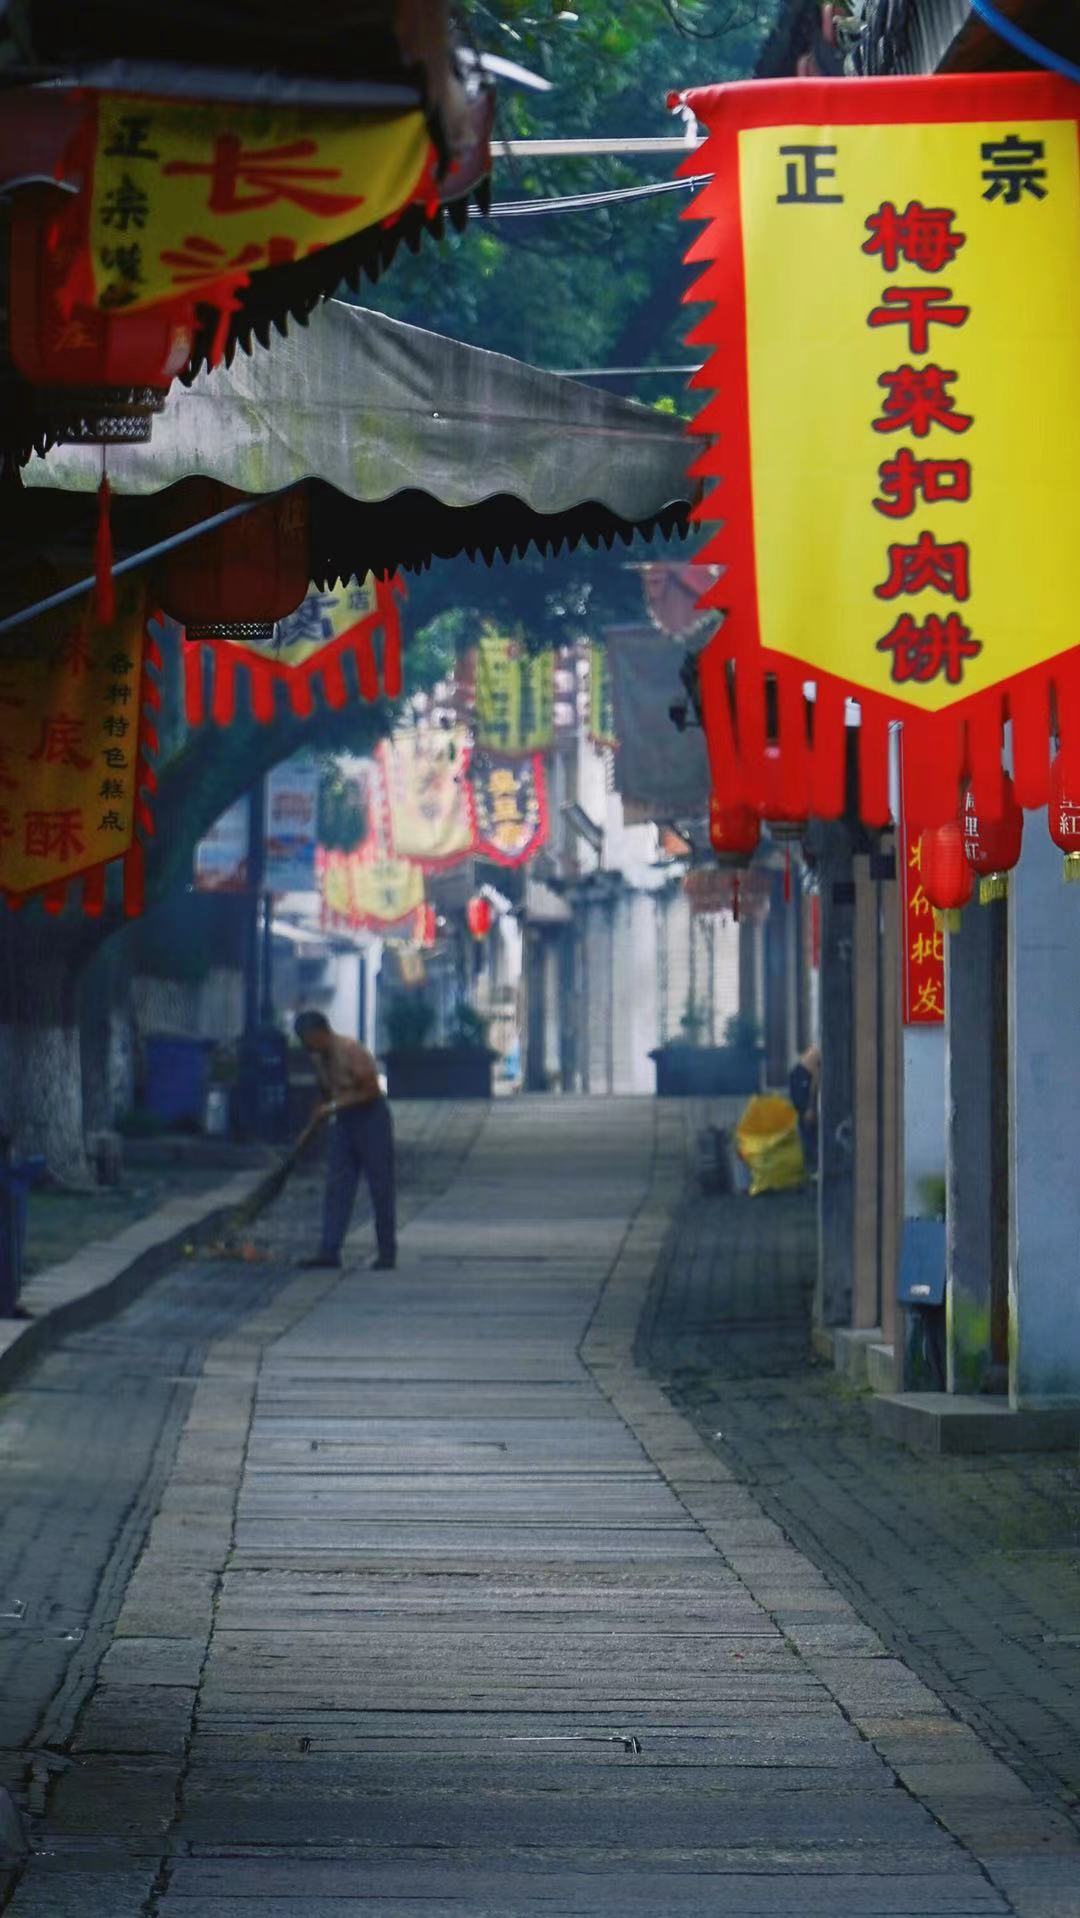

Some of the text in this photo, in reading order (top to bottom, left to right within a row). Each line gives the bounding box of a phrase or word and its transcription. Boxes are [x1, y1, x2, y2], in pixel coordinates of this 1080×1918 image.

[777, 135, 1048, 204] 正宗
[861, 200, 983, 685] 梅干菜扣肉饼
[98, 652, 135, 834] 各种特色糕点
